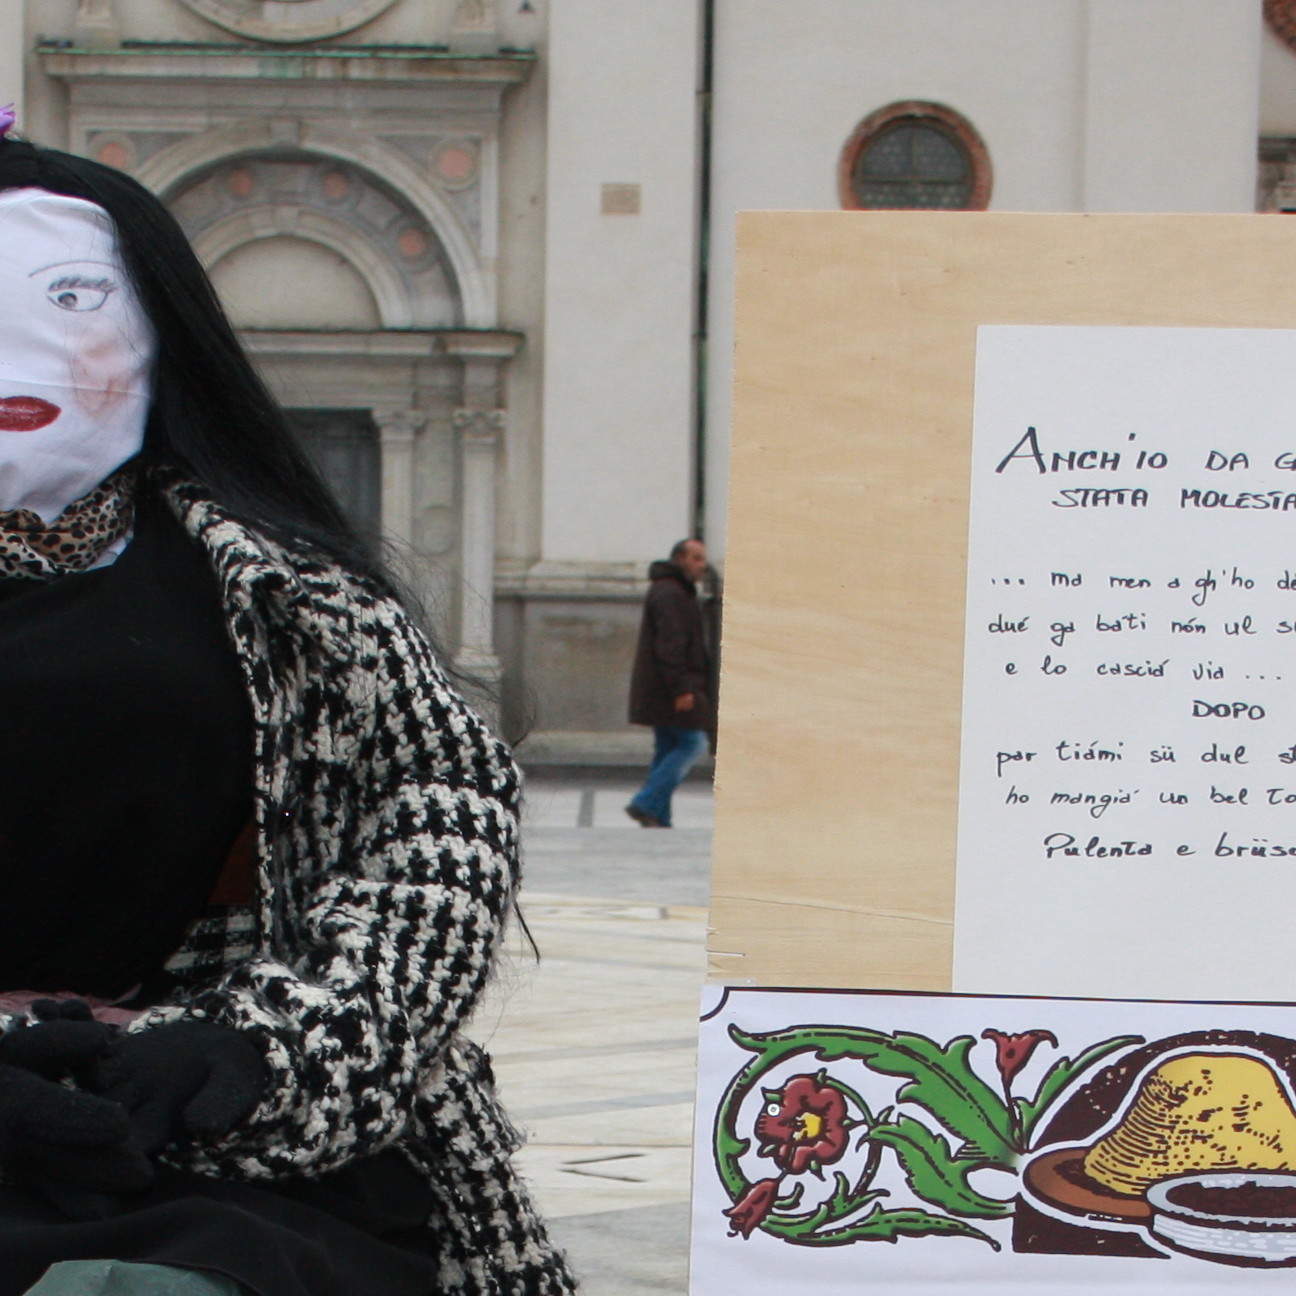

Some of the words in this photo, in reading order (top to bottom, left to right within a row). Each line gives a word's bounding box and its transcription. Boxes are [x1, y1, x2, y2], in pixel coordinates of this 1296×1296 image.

[1204, 450, 1250, 472] DA
[1051, 488, 1149, 509] STATA
[1050, 571, 1083, 588] ma
[1109, 575, 1152, 590] men
[1166, 576, 1181, 589] a
[1049, 621, 1076, 648] ga
[1004, 661, 1019, 676] e
[1039, 654, 1068, 676] lo
[1191, 660, 1225, 681] via
[1191, 699, 1266, 721] DOPO
[995, 750, 1038, 779] par
[1005, 784, 1030, 805] ho
[1158, 791, 1189, 806] un
[1209, 784, 1249, 806] bel
[1175, 844, 1197, 857] e
